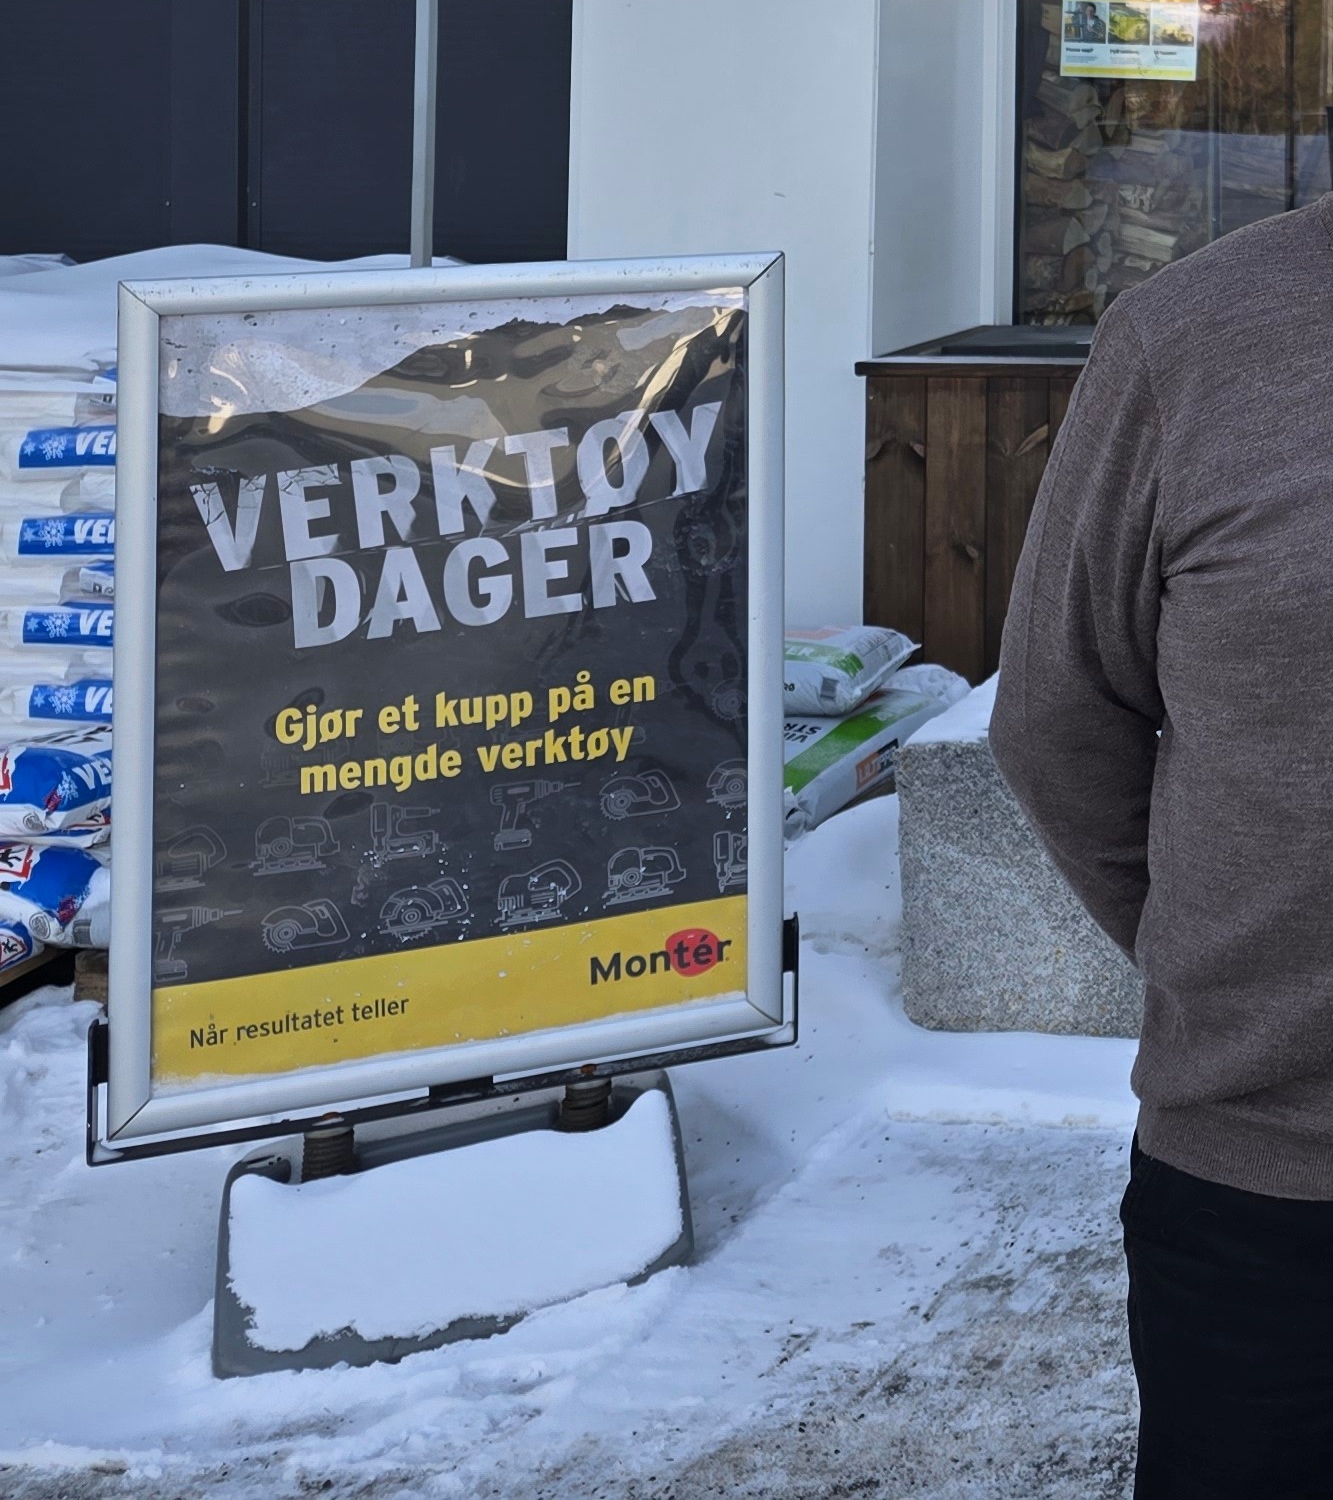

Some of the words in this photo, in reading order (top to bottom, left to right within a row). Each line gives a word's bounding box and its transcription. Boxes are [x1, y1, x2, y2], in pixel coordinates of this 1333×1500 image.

[189, 401, 723, 572] VERKTØY
[290, 520, 657, 649] DAGER
[275, 704, 363, 751] Gjør
[377, 694, 420, 735] et
[435, 691, 533, 730] kupp
[548, 670, 596, 723] på
[609, 675, 656, 705] en
[300, 743, 463, 795] mengde
[476, 725, 635, 773] verktøy
[589, 934, 732, 986] Montér
[189, 1013, 228, 1049] Når
[235, 1004, 345, 1042] resultatet
[351, 998, 409, 1023] teller
